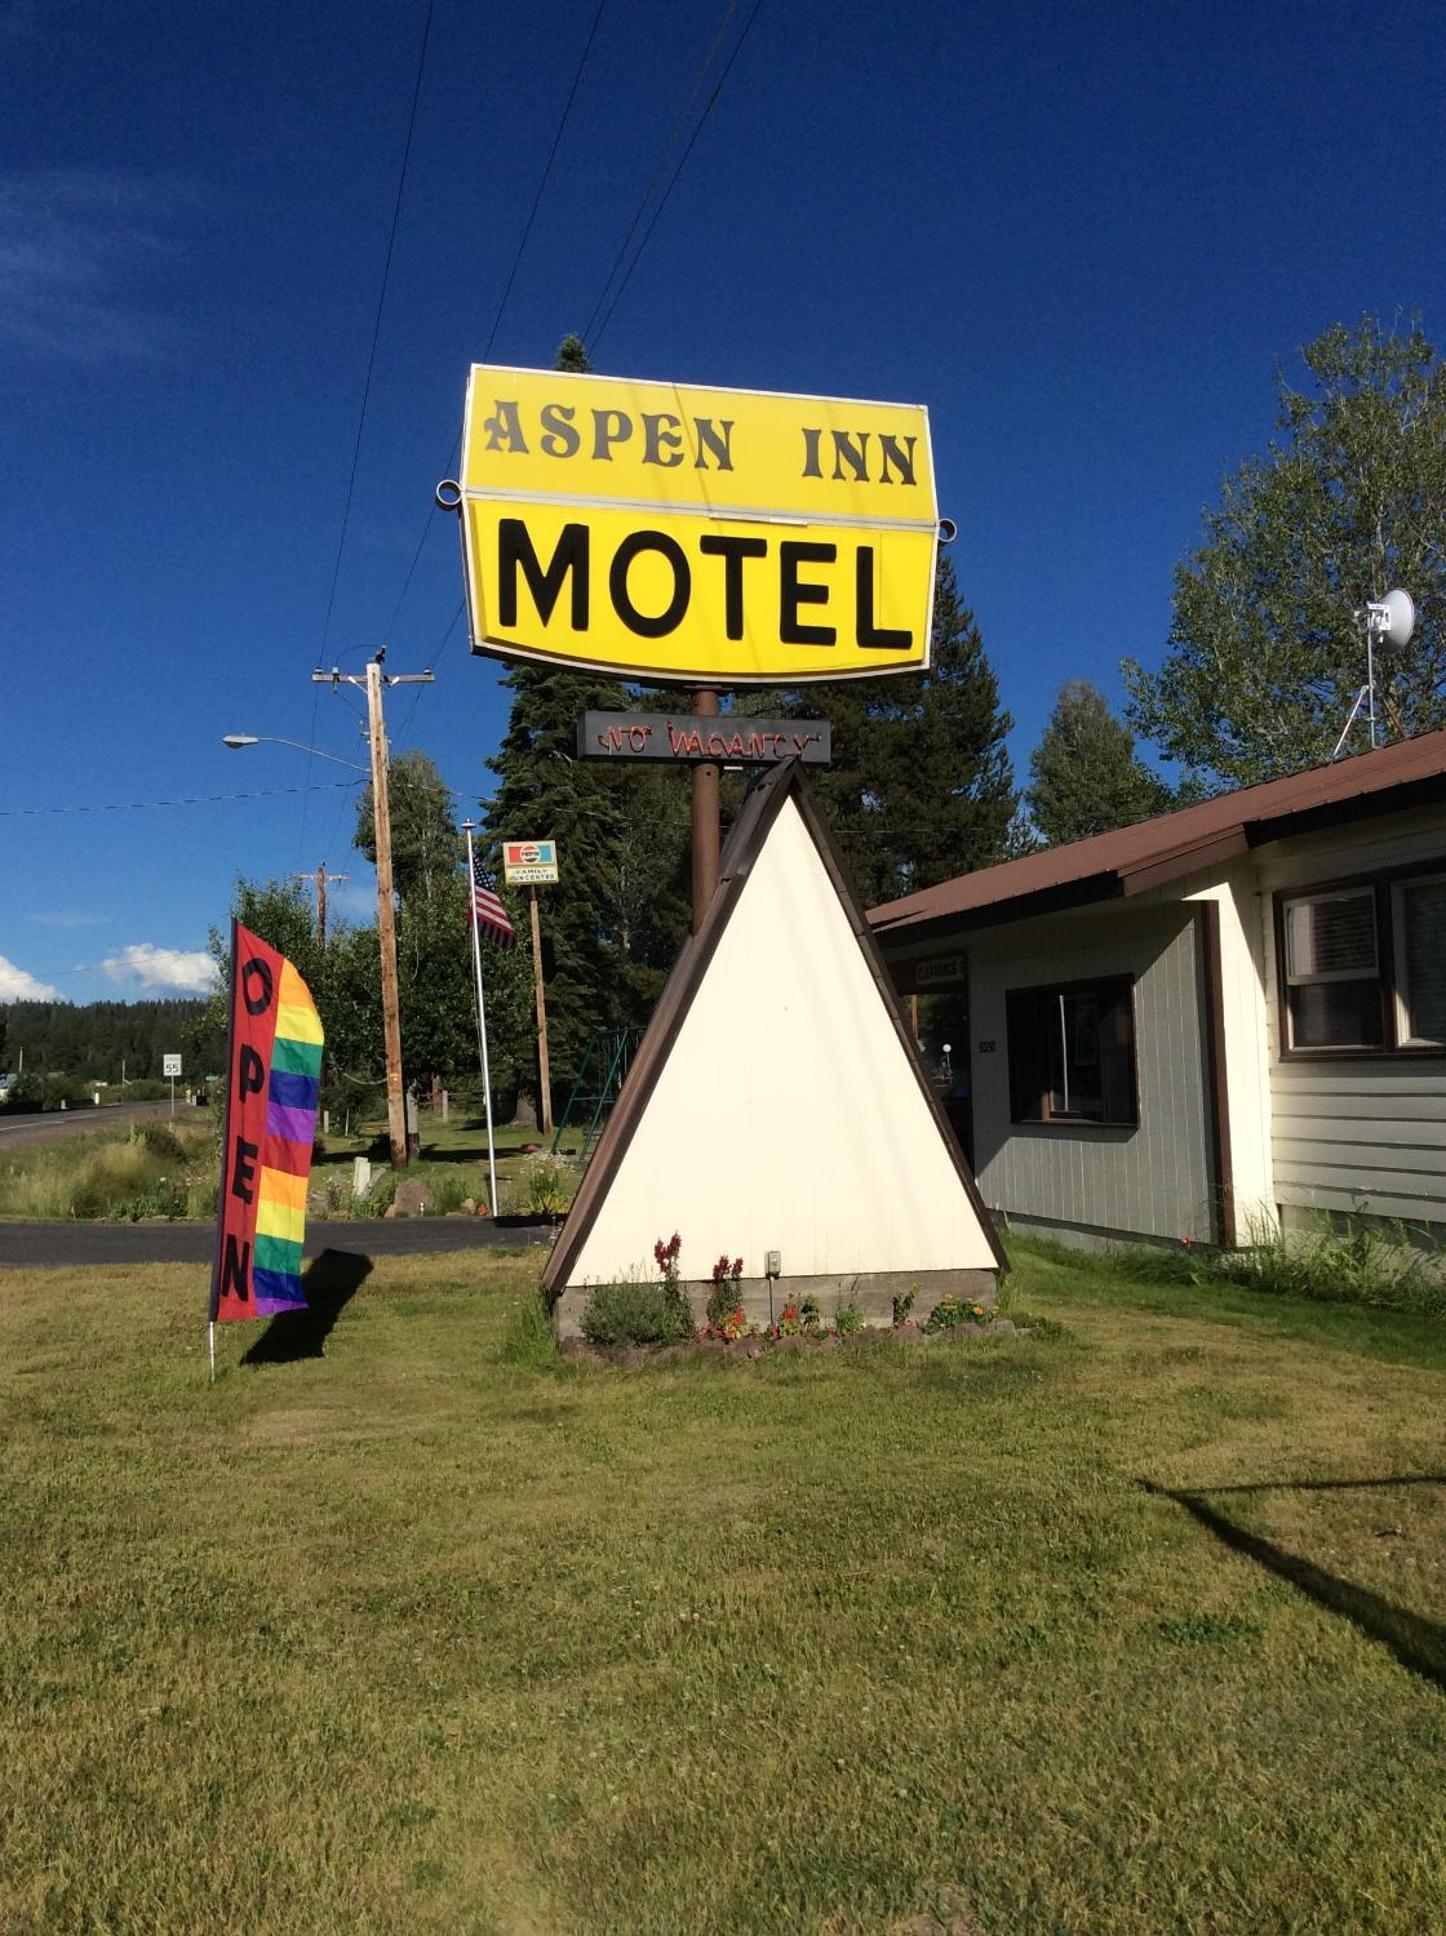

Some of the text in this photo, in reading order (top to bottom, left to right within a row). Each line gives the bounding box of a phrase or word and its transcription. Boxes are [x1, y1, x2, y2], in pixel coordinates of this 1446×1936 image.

[484, 400, 918, 486] ASPEN INN
[499, 518, 913, 650] MOTEL
[597, 725, 653, 753] NO
[166, 1063, 178, 1073] 55
[220, 957, 272, 1301] OPEN
